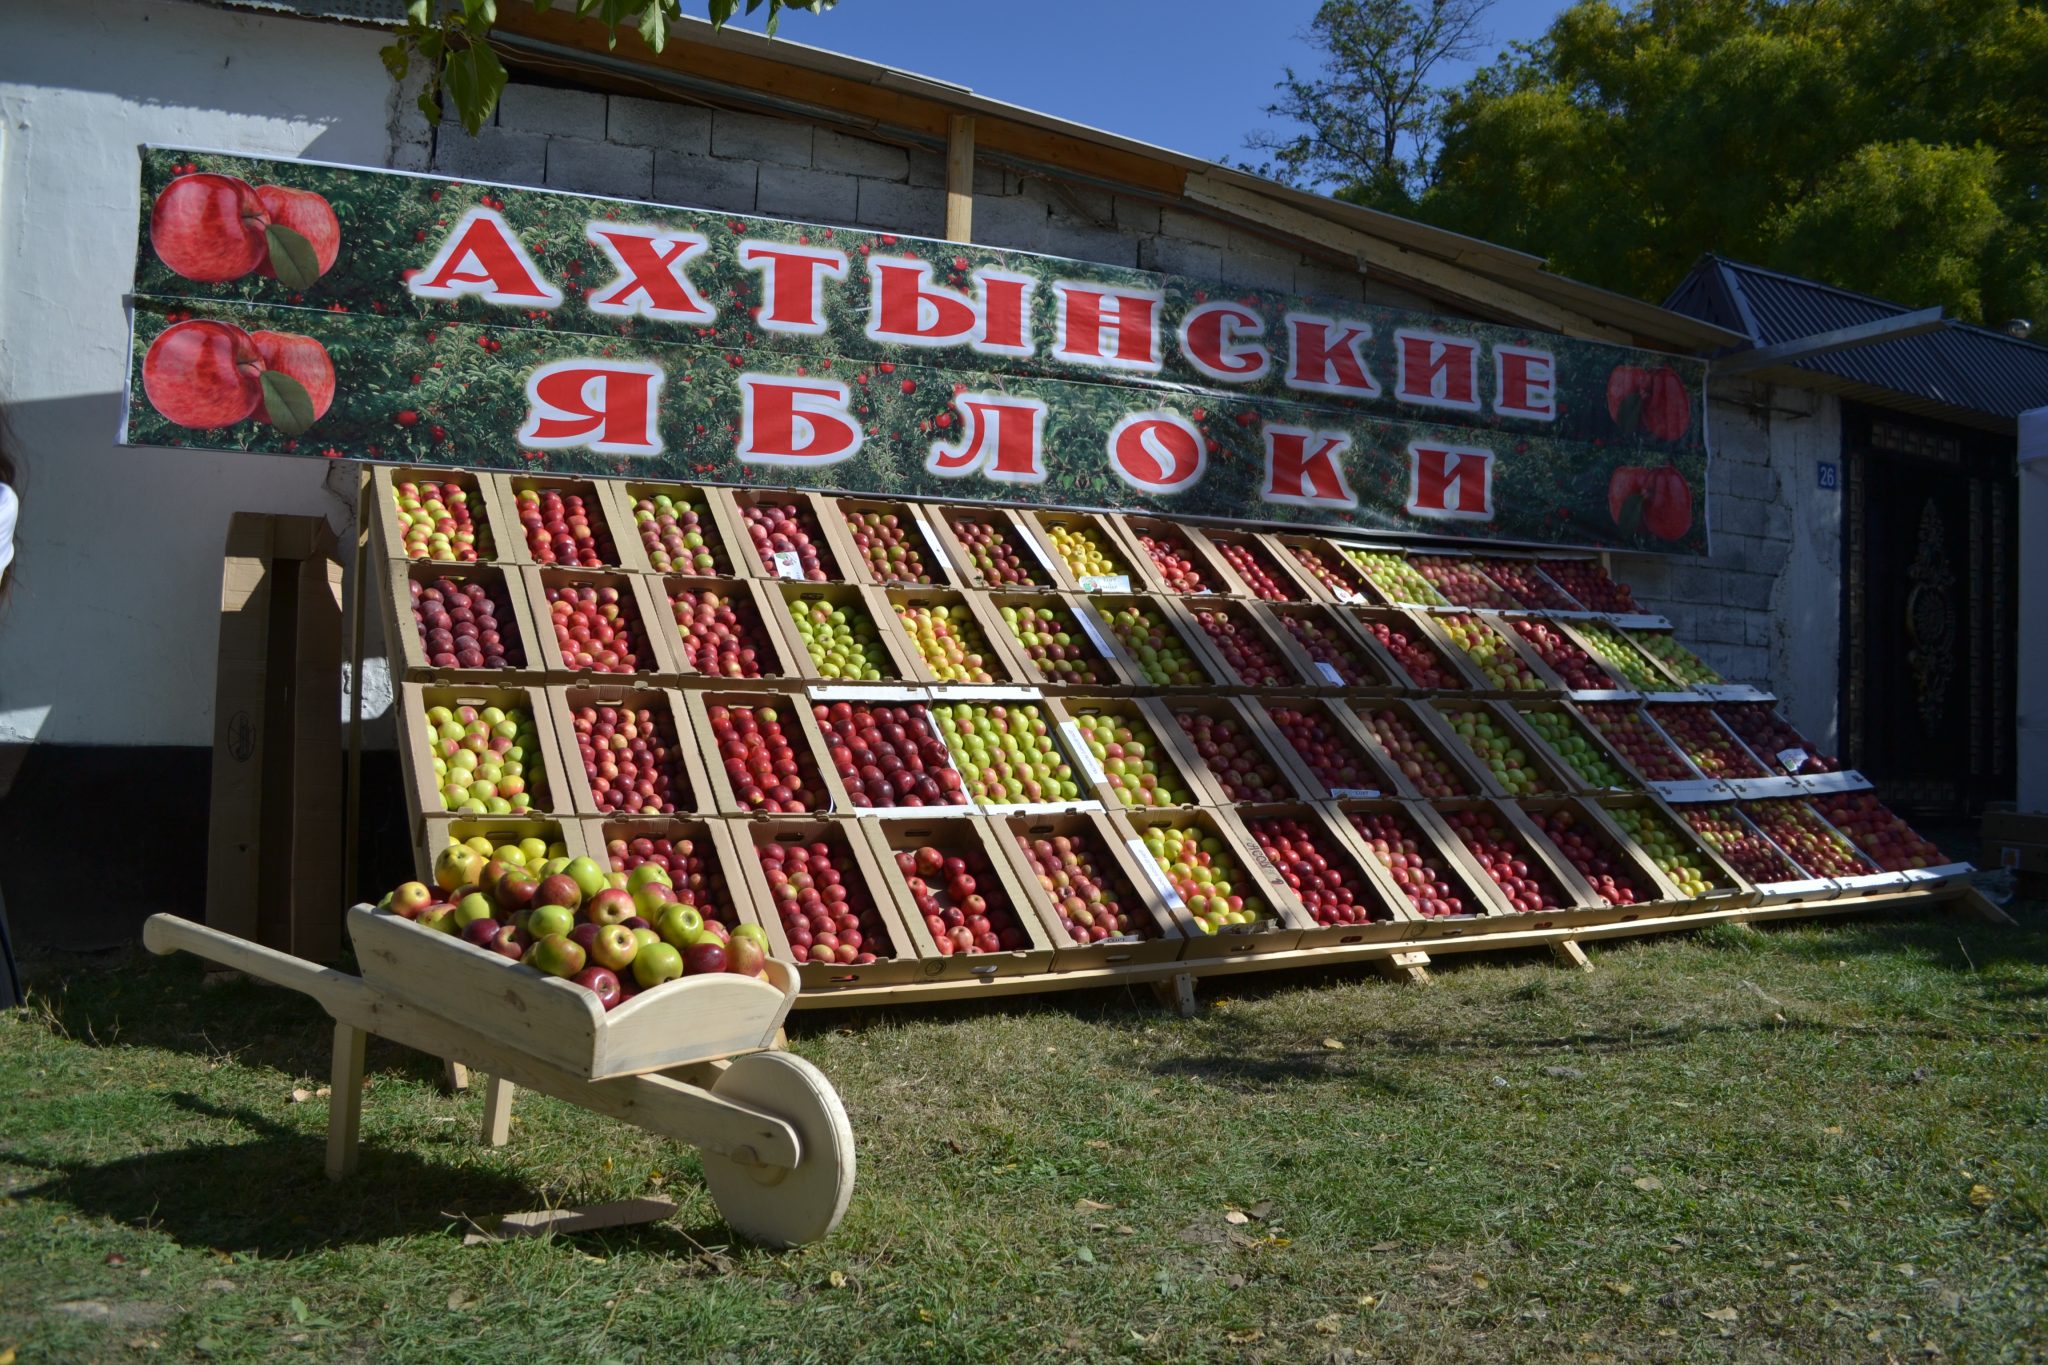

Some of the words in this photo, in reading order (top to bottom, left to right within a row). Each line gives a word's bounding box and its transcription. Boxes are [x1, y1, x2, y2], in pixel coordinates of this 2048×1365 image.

[410, 207, 1555, 420] АХТЫНСКИЕ
[518, 360, 1494, 519] ЯБЛОКИ
[1820, 466, 1834, 486] 26
